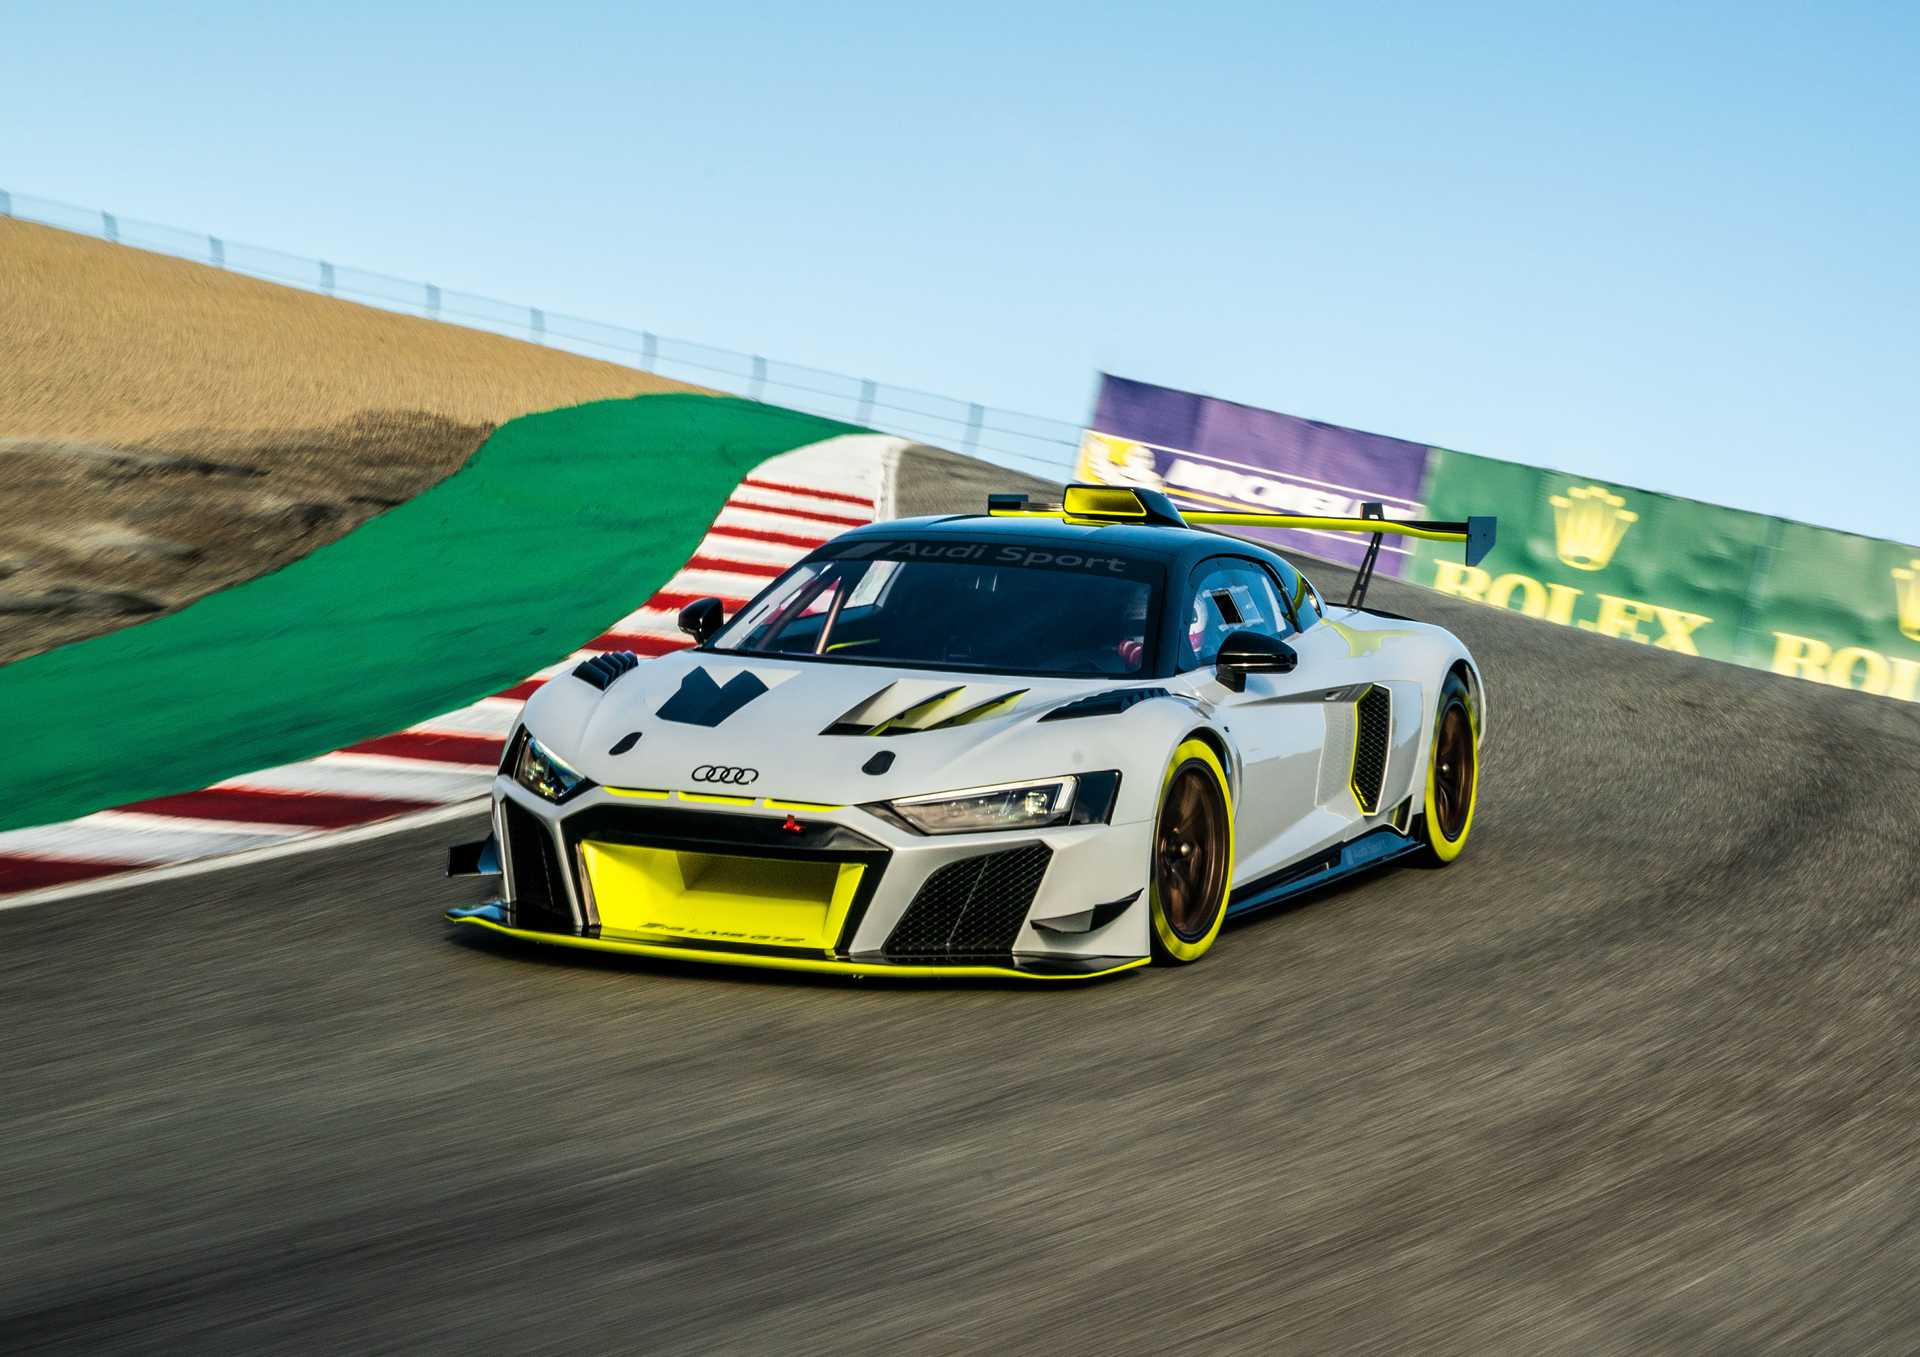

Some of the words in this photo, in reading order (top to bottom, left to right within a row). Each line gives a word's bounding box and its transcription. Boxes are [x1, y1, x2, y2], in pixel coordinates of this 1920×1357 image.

[886, 542, 989, 559] Audi
[995, 546, 1128, 573] Sport
[1433, 559, 1713, 656] ROLEX
